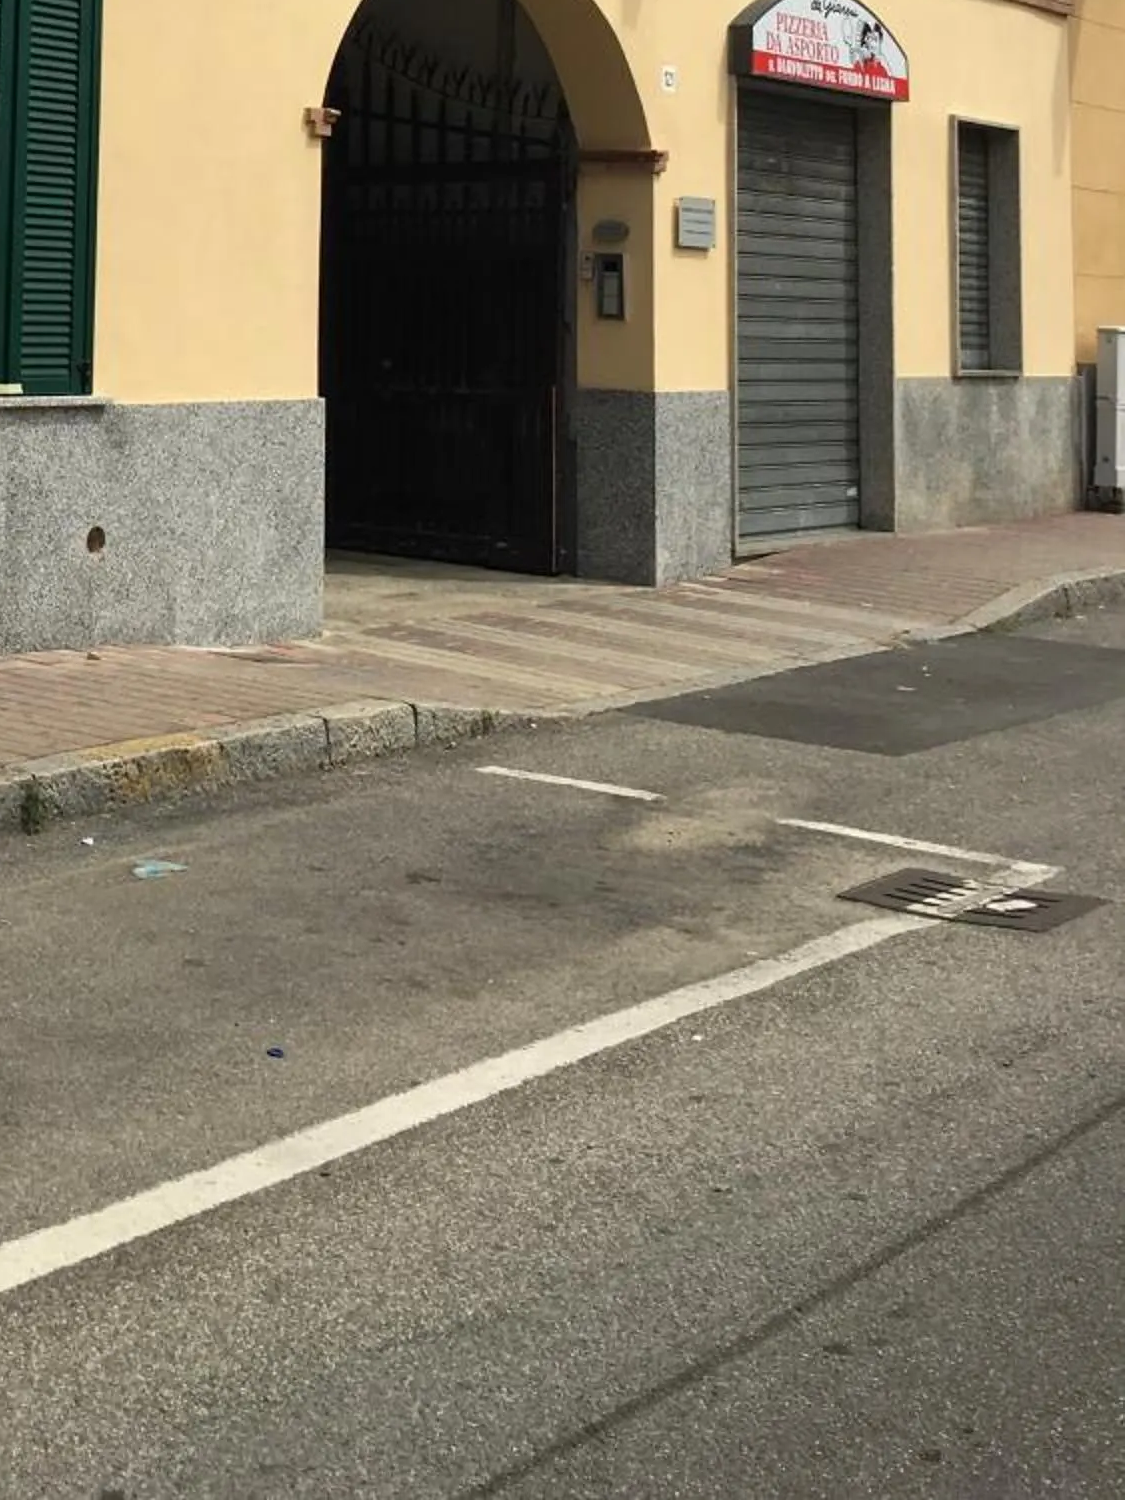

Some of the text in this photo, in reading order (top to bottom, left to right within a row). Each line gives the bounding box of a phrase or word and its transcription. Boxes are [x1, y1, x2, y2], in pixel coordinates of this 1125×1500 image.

[776, 11, 829, 41] PIZZERIA
[766, 30, 839, 63] DA ASPORTO
[838, 68, 863, 87] FORNO
[864, 73, 872, 89] A
[872, 75, 896, 96] LEGNA
